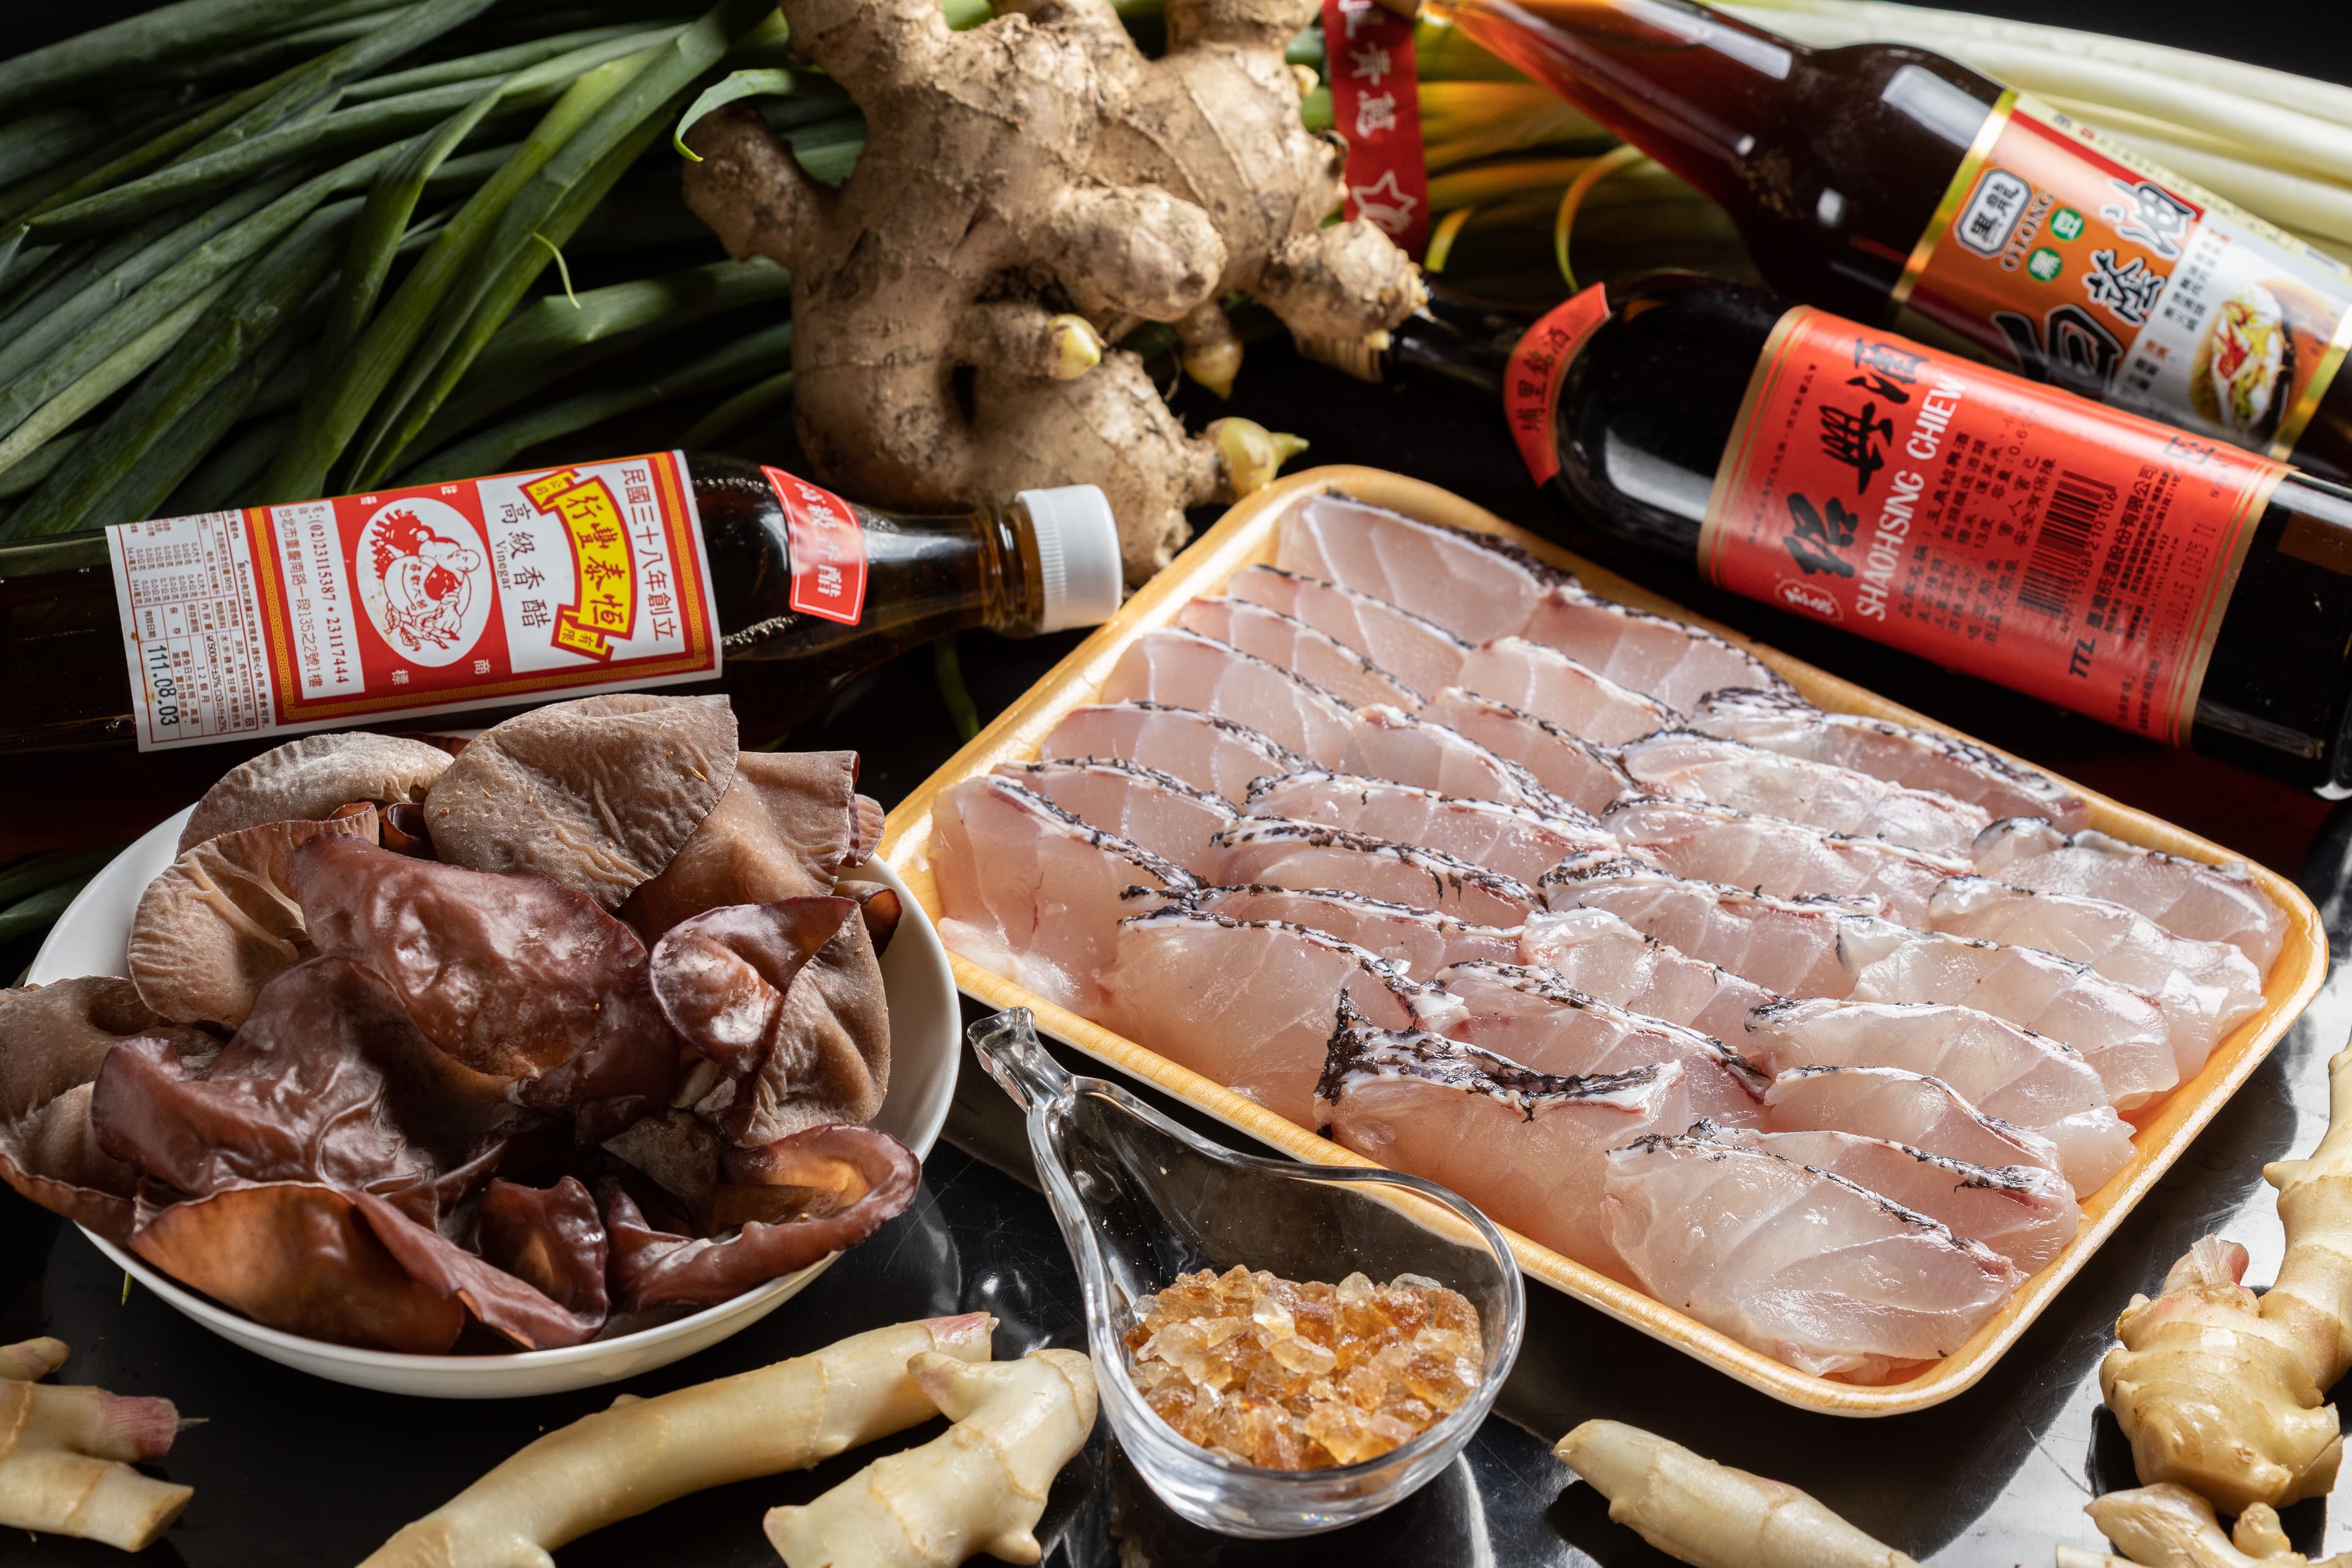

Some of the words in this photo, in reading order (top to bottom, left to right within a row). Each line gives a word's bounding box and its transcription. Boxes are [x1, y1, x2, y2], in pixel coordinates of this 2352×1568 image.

[1780, 337, 1931, 579] 紹興酒
[1856, 469, 1924, 622] SHAOHSING
[1906, 374, 1967, 461] CHIEW
[494, 540, 512, 591] Vinegar
[499, 500, 552, 630] 高級香醋
[621, 466, 677, 641] 民國三十八年創立
[147, 644, 181, 726] 111.08.03
[325, 616, 350, 684] 23117444
[2068, 632, 2097, 681] TTL
